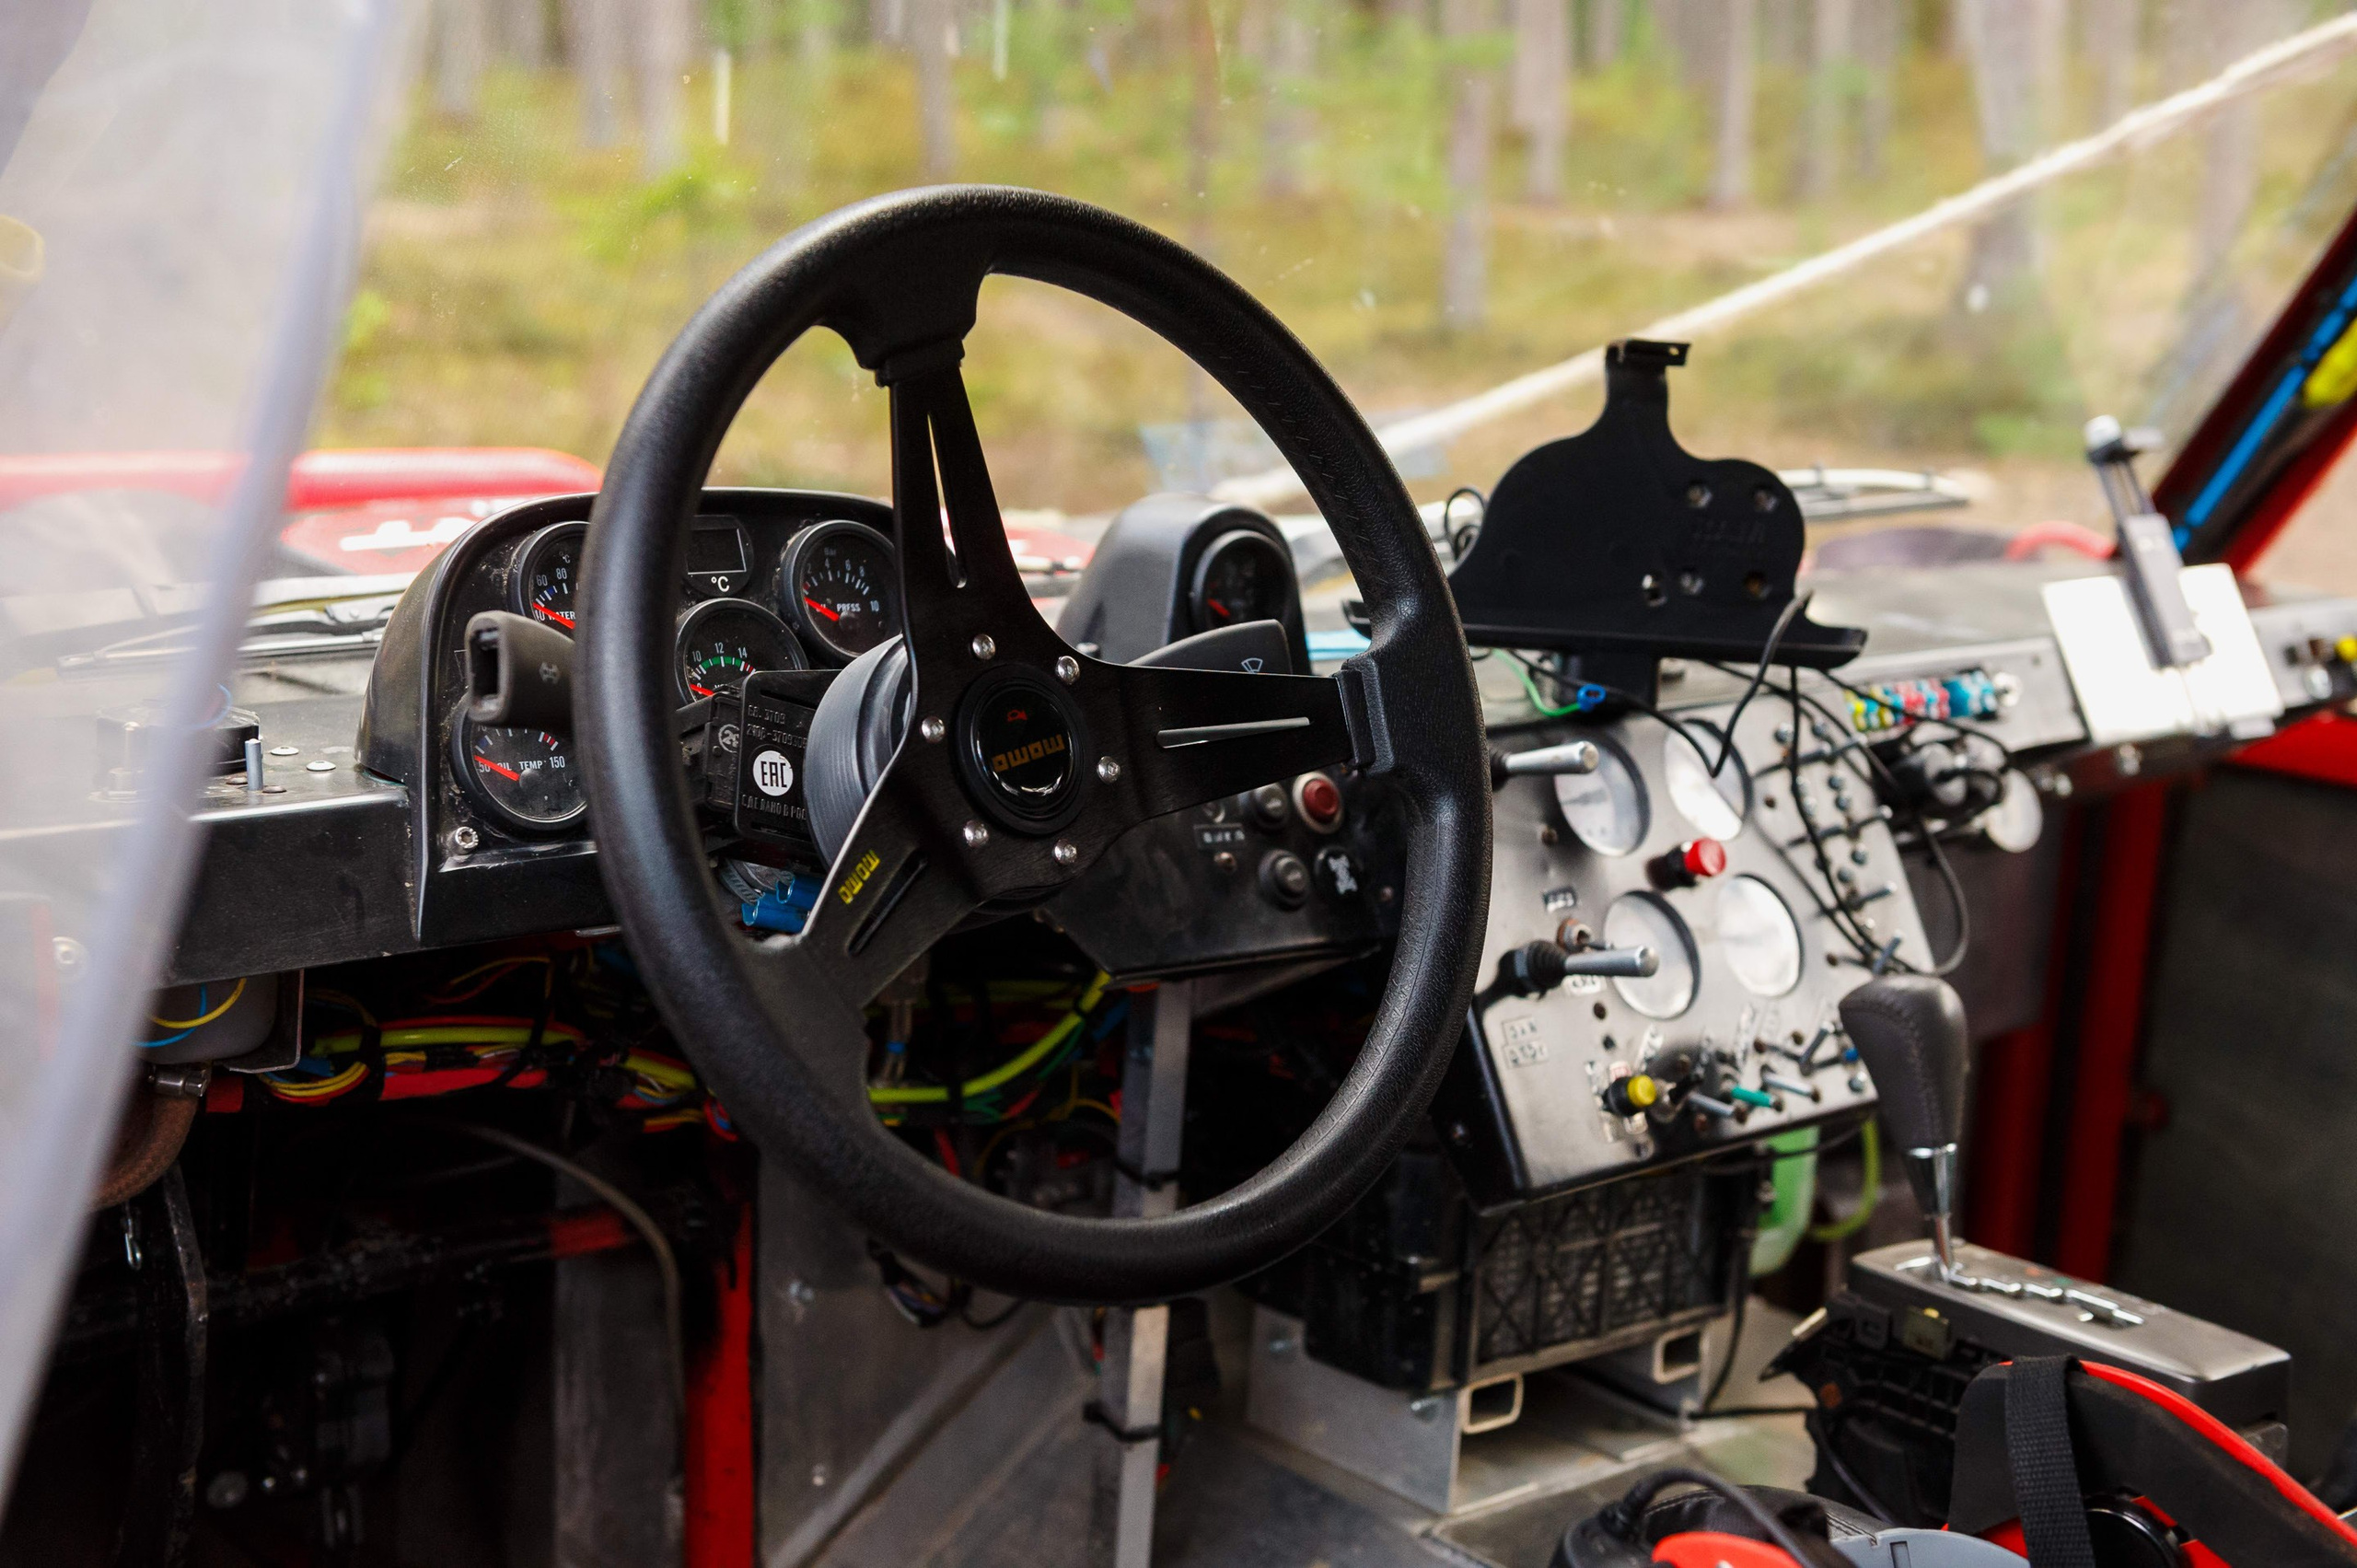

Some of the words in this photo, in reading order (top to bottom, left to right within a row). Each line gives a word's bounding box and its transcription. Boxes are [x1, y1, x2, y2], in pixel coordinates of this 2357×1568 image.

[555, 567, 567, 580] 80
[536, 575, 548, 587] 60
[836, 603, 861, 612] PRESS
[870, 599, 880, 612] 10
[714, 643, 725, 654] 12
[737, 646, 748, 658] 14
[692, 650, 702, 662] 10
[479, 761, 491, 772] 50
[518, 760, 543, 771] TEMP
[549, 755, 565, 768] 150
[761, 761, 787, 788] EAC
